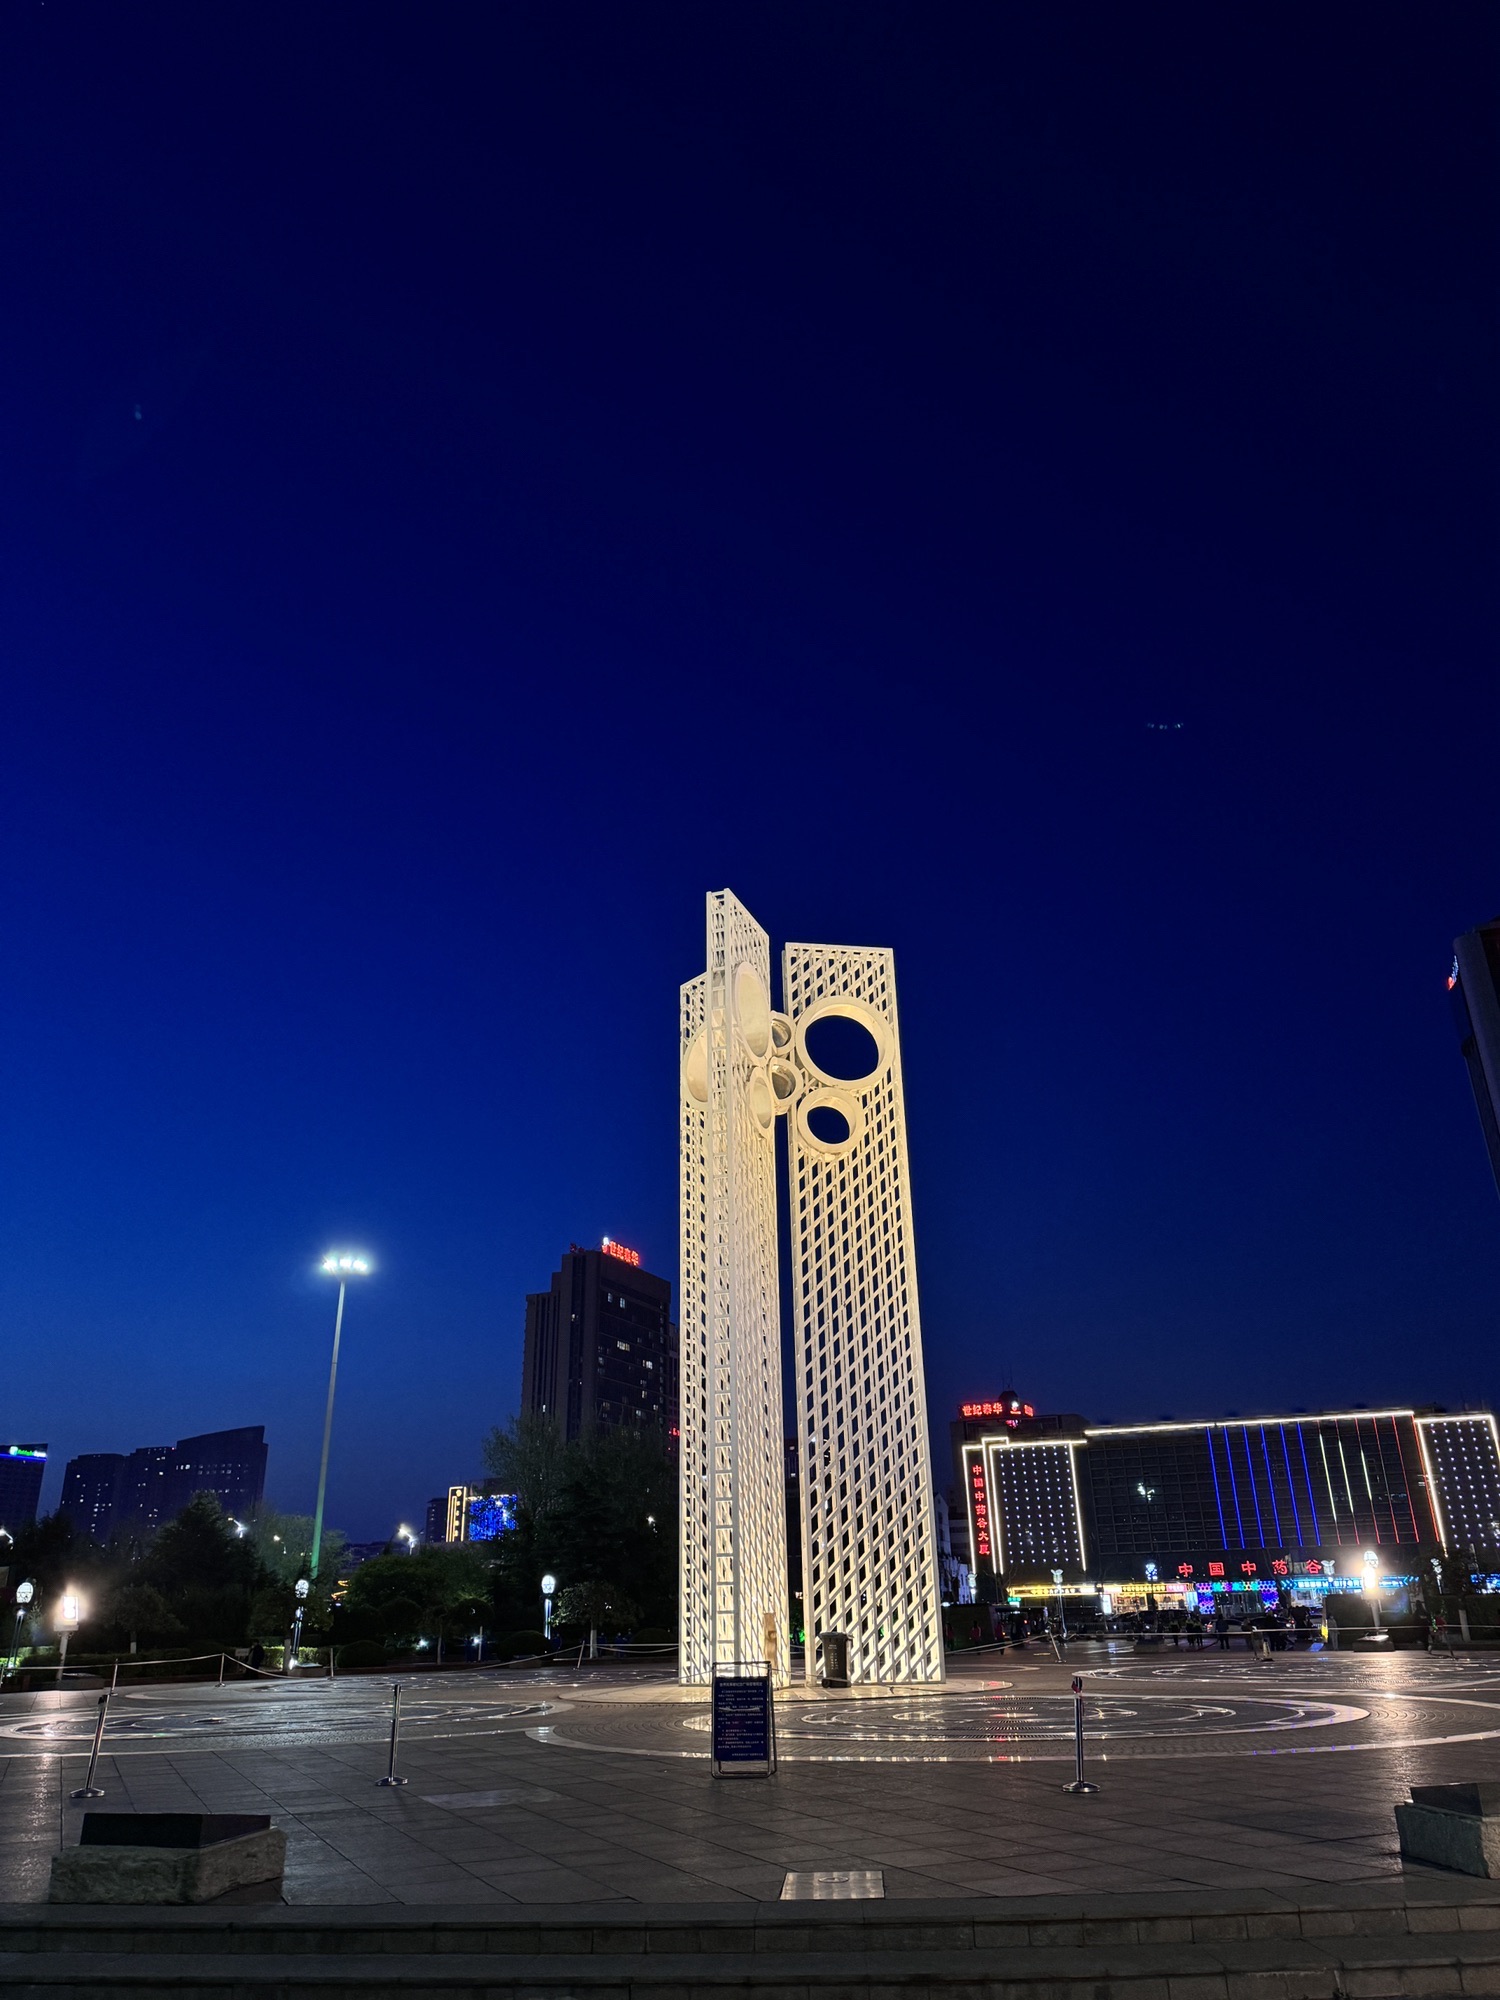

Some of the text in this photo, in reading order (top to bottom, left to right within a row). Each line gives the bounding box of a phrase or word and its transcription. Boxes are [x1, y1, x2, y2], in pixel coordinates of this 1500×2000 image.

[962, 1402, 1003, 1417] 世纪泰华
[972, 1464, 991, 1556] 中国中药谷大厦
[1178, 1559, 1322, 1578] 中国中药谷
